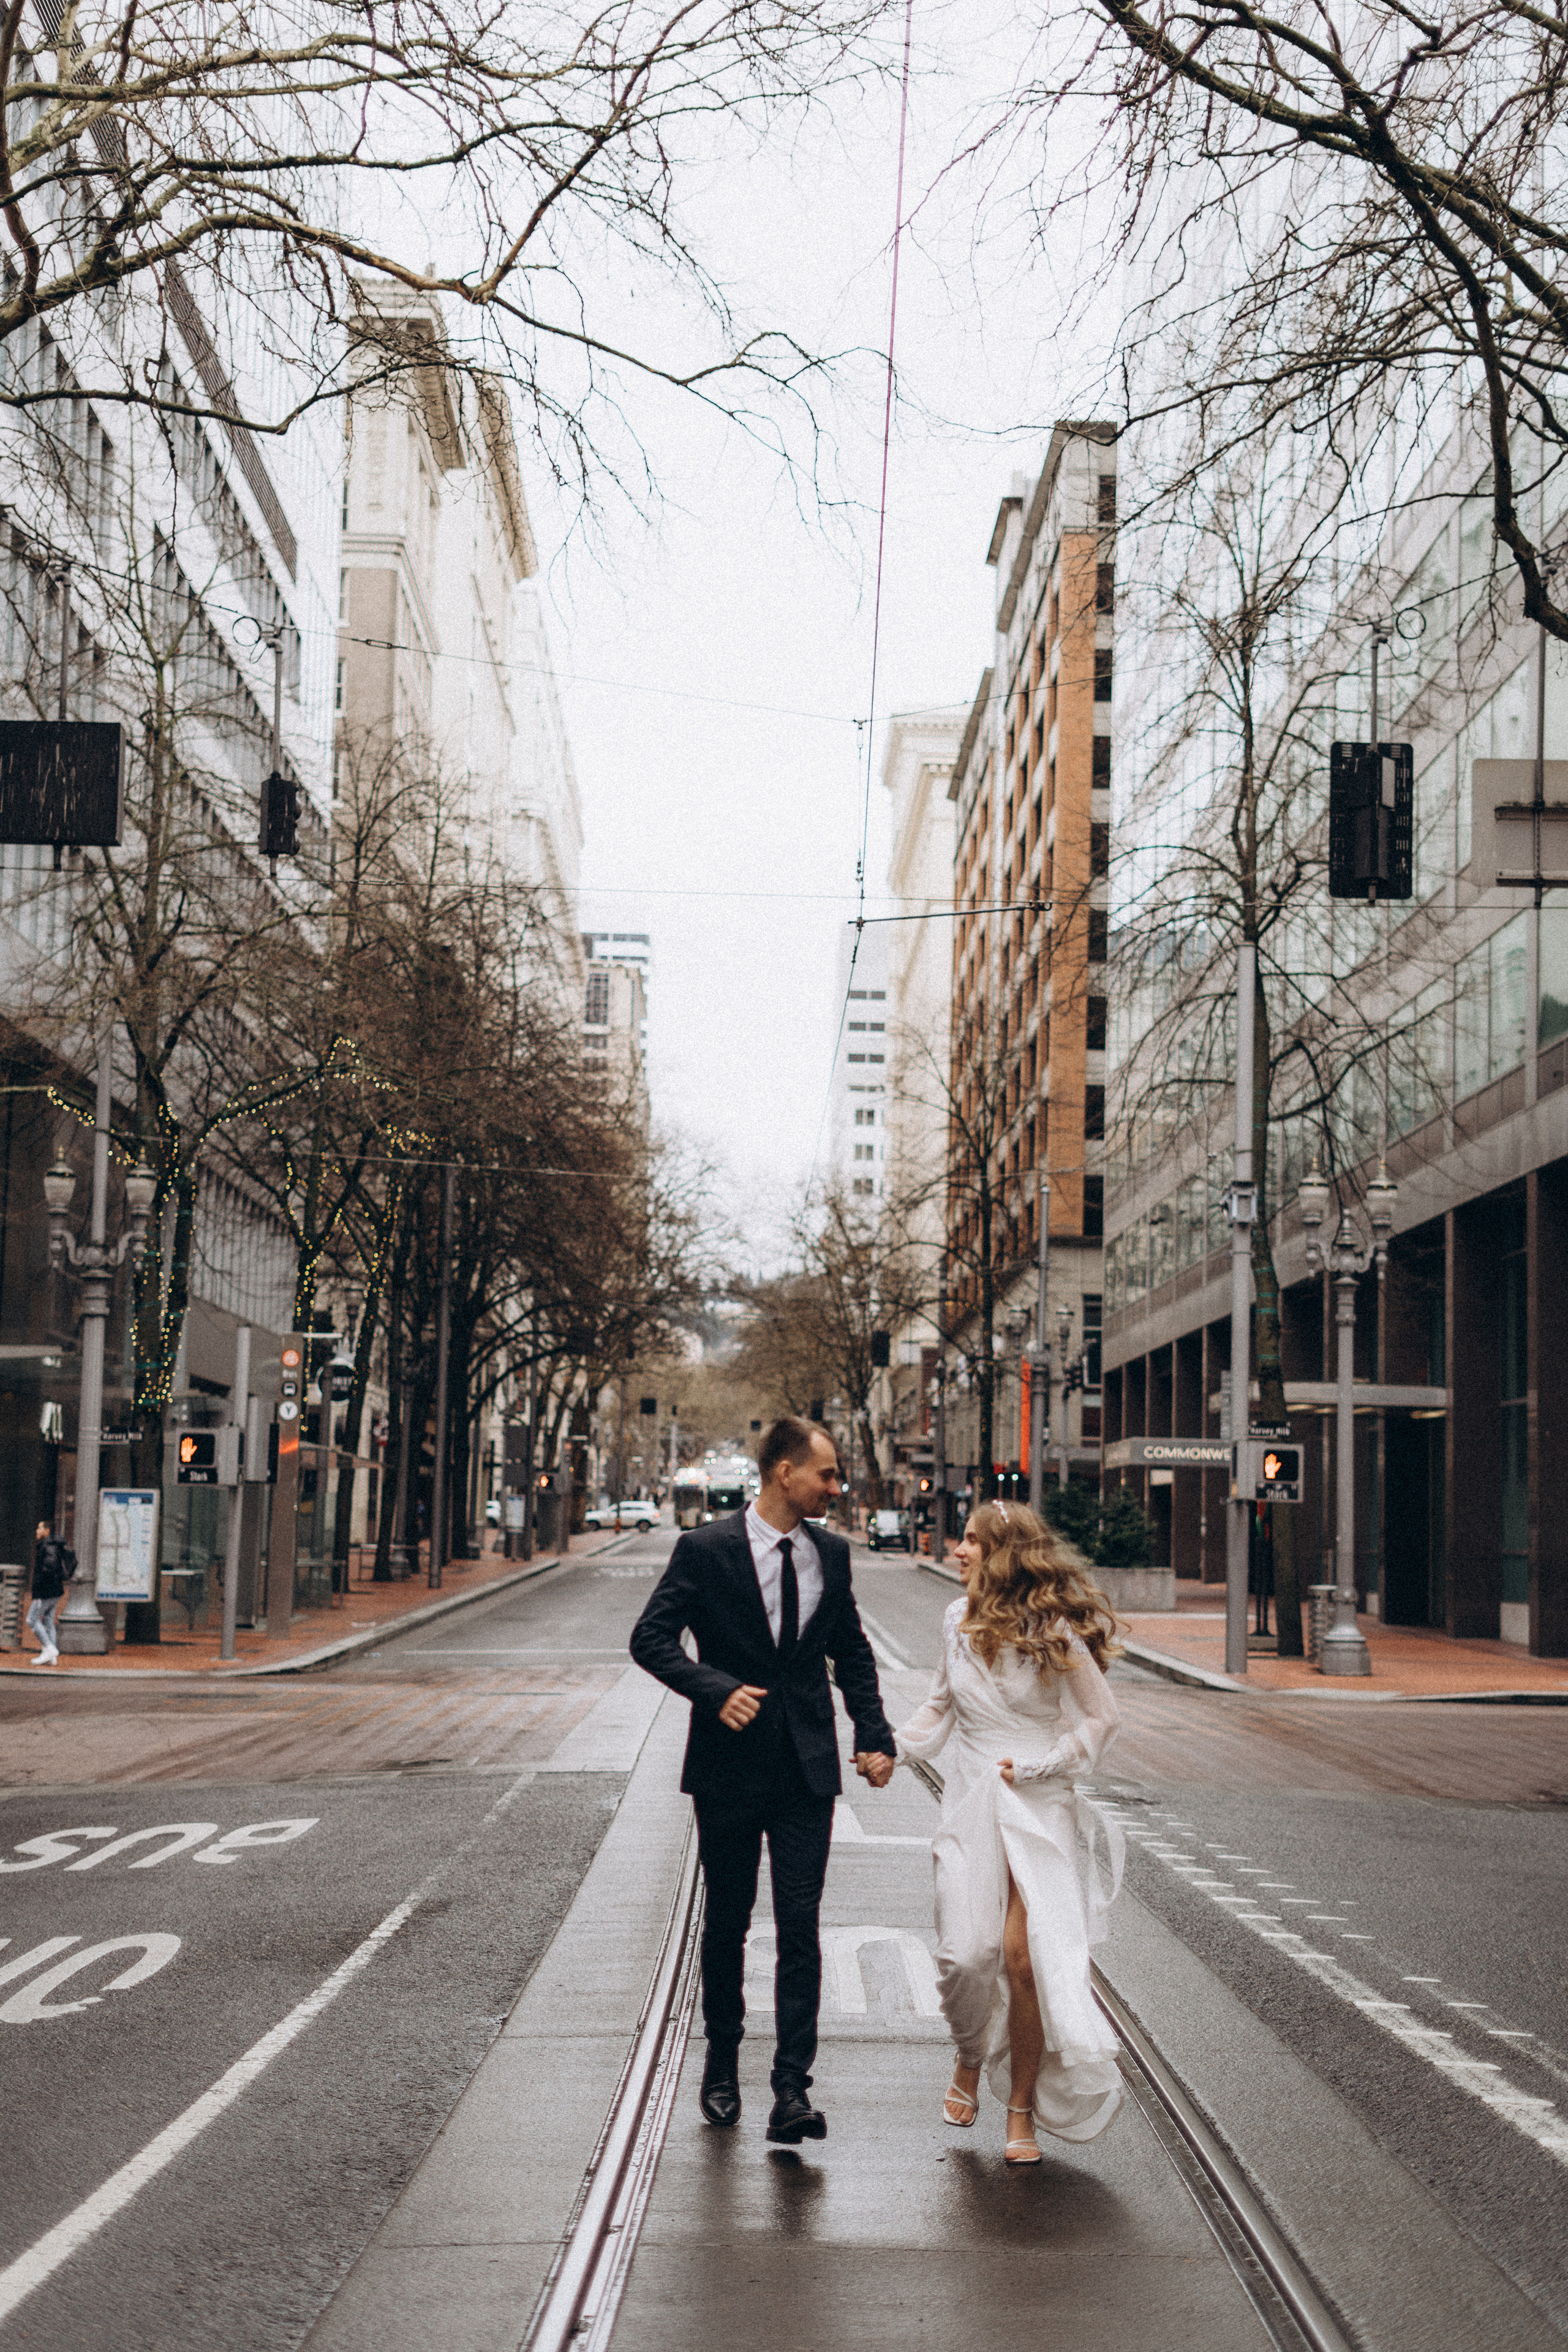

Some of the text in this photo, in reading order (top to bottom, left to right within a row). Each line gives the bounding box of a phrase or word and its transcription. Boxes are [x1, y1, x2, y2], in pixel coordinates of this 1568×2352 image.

[1250, 1427, 1274, 1436] Harvey
[1266, 1489, 1288, 1499] Stark
[0, 1817, 320, 1873] BUS
